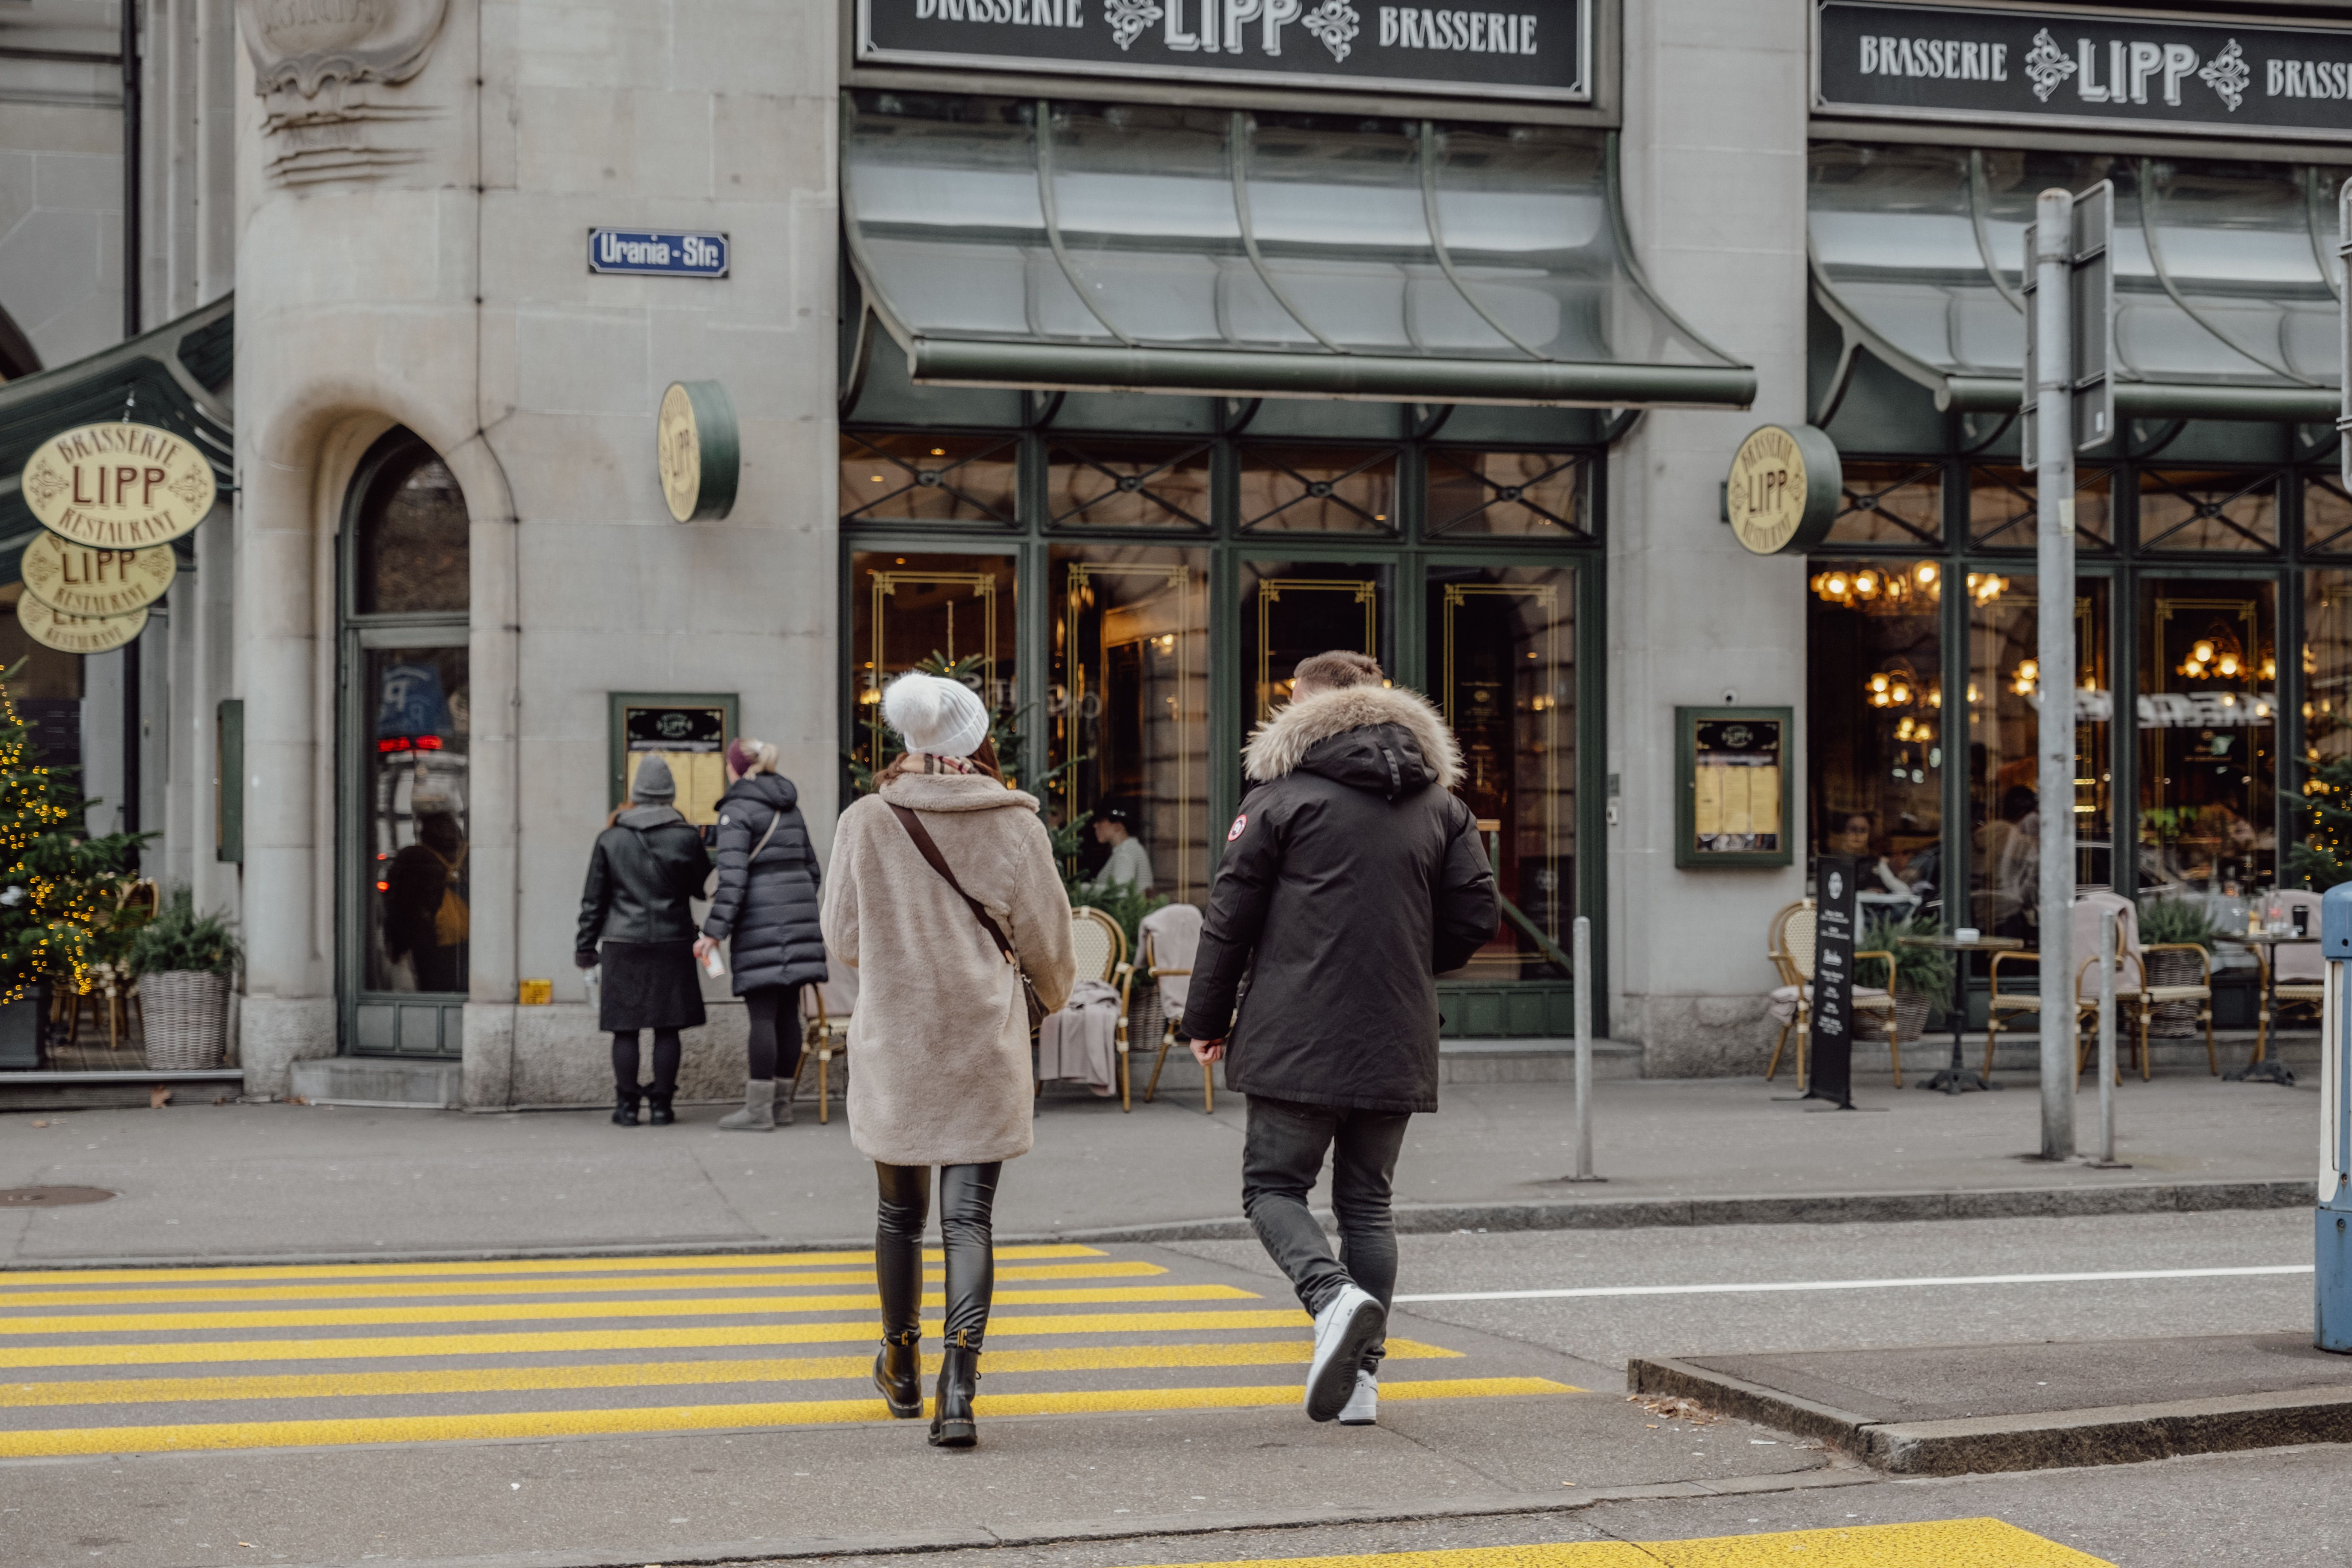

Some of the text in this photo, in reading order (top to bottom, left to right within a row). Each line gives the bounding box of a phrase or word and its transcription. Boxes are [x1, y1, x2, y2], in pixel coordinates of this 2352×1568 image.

[1164, 0, 1302, 56] LIPP
[1379, 6, 1537, 55] BRASSERIE
[1859, 35, 2007, 81] BRASSERIE
[2077, 38, 2200, 106] LIPP
[56, 426, 182, 468] BRASSERIE
[72, 466, 170, 510] LIPP
[1747, 470, 1788, 518] LIPP
[58, 507, 178, 546] RESTAURANT
[61, 550, 136, 586] LIPP
